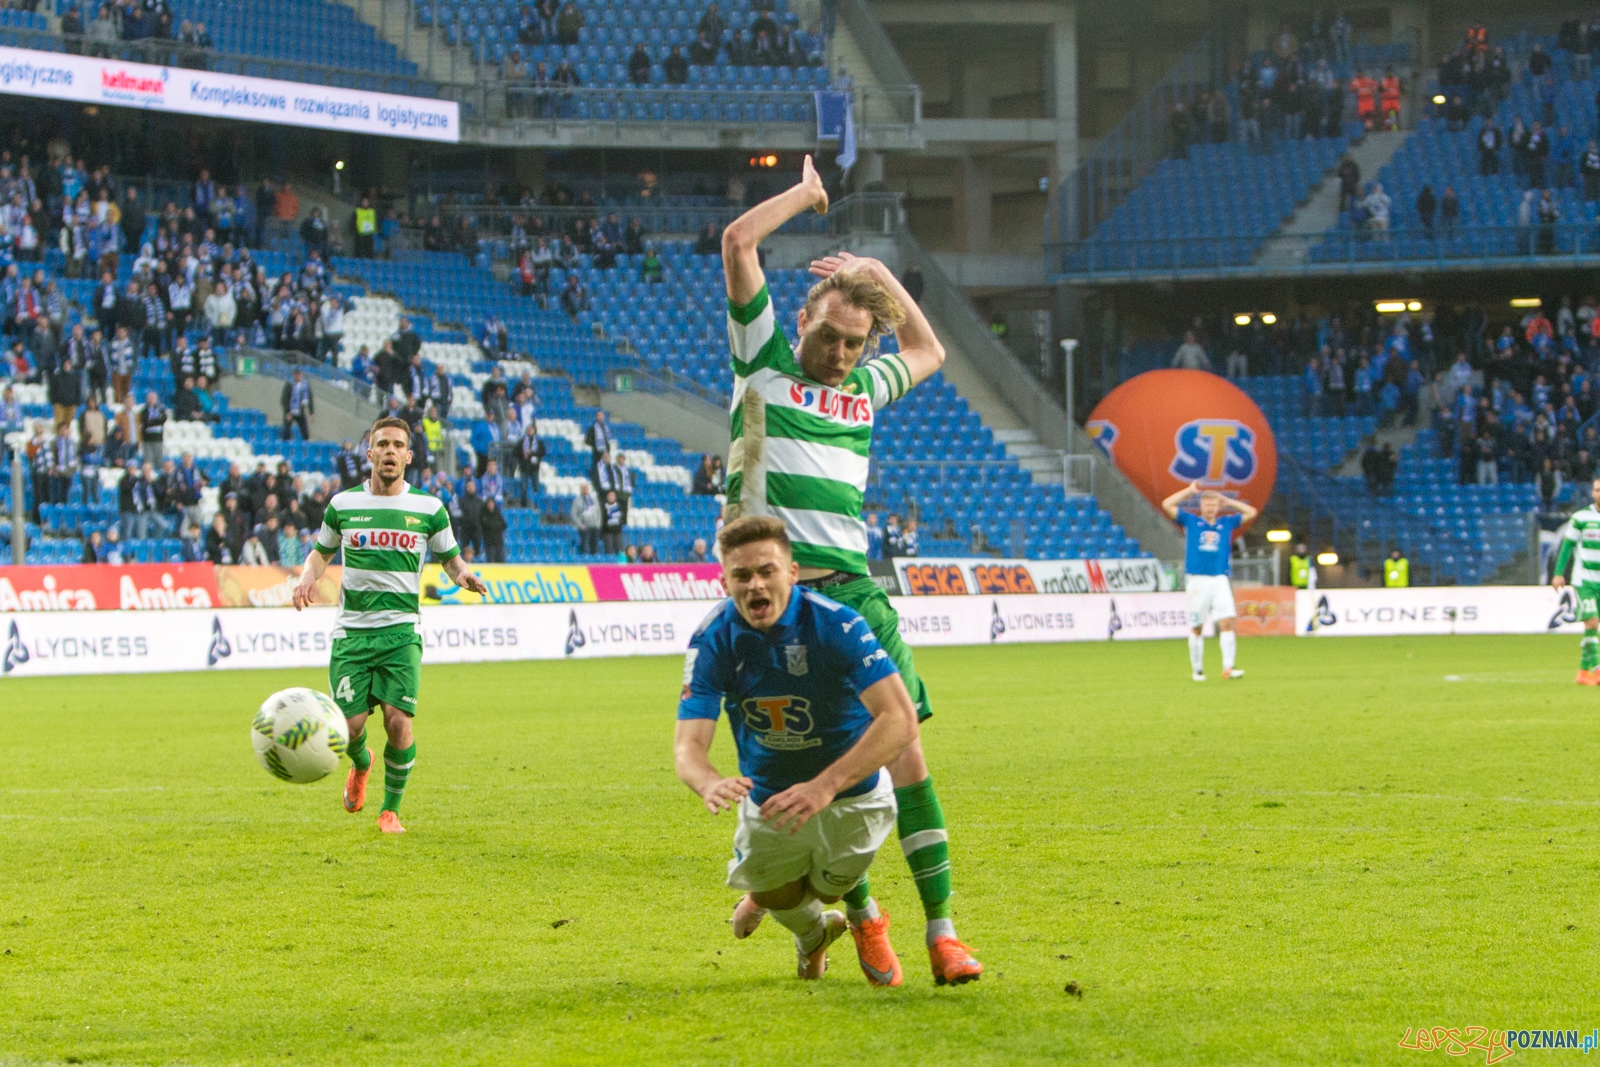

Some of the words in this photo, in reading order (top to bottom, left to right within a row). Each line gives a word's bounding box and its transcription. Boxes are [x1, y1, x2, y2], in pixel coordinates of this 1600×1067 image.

[190, 81, 286, 109] Kompleksowe
[294, 97, 370, 120] rozwiązania
[377, 102, 449, 129] logistyczne
[818, 389, 871, 422] LOTOS
[1168, 417, 1258, 487] STS
[370, 531, 417, 549] LOTOS
[0, 574, 97, 611] Amica
[119, 572, 212, 609] Amica
[1007, 612, 1074, 630] LYONESS
[1121, 609, 1187, 627] LYONESS
[1344, 606, 1478, 623] LYONESS
[423, 628, 518, 648] LYONESS
[589, 623, 674, 643] LYONESS
[35, 636, 148, 658] LYONESS
[741, 695, 815, 735] STS
